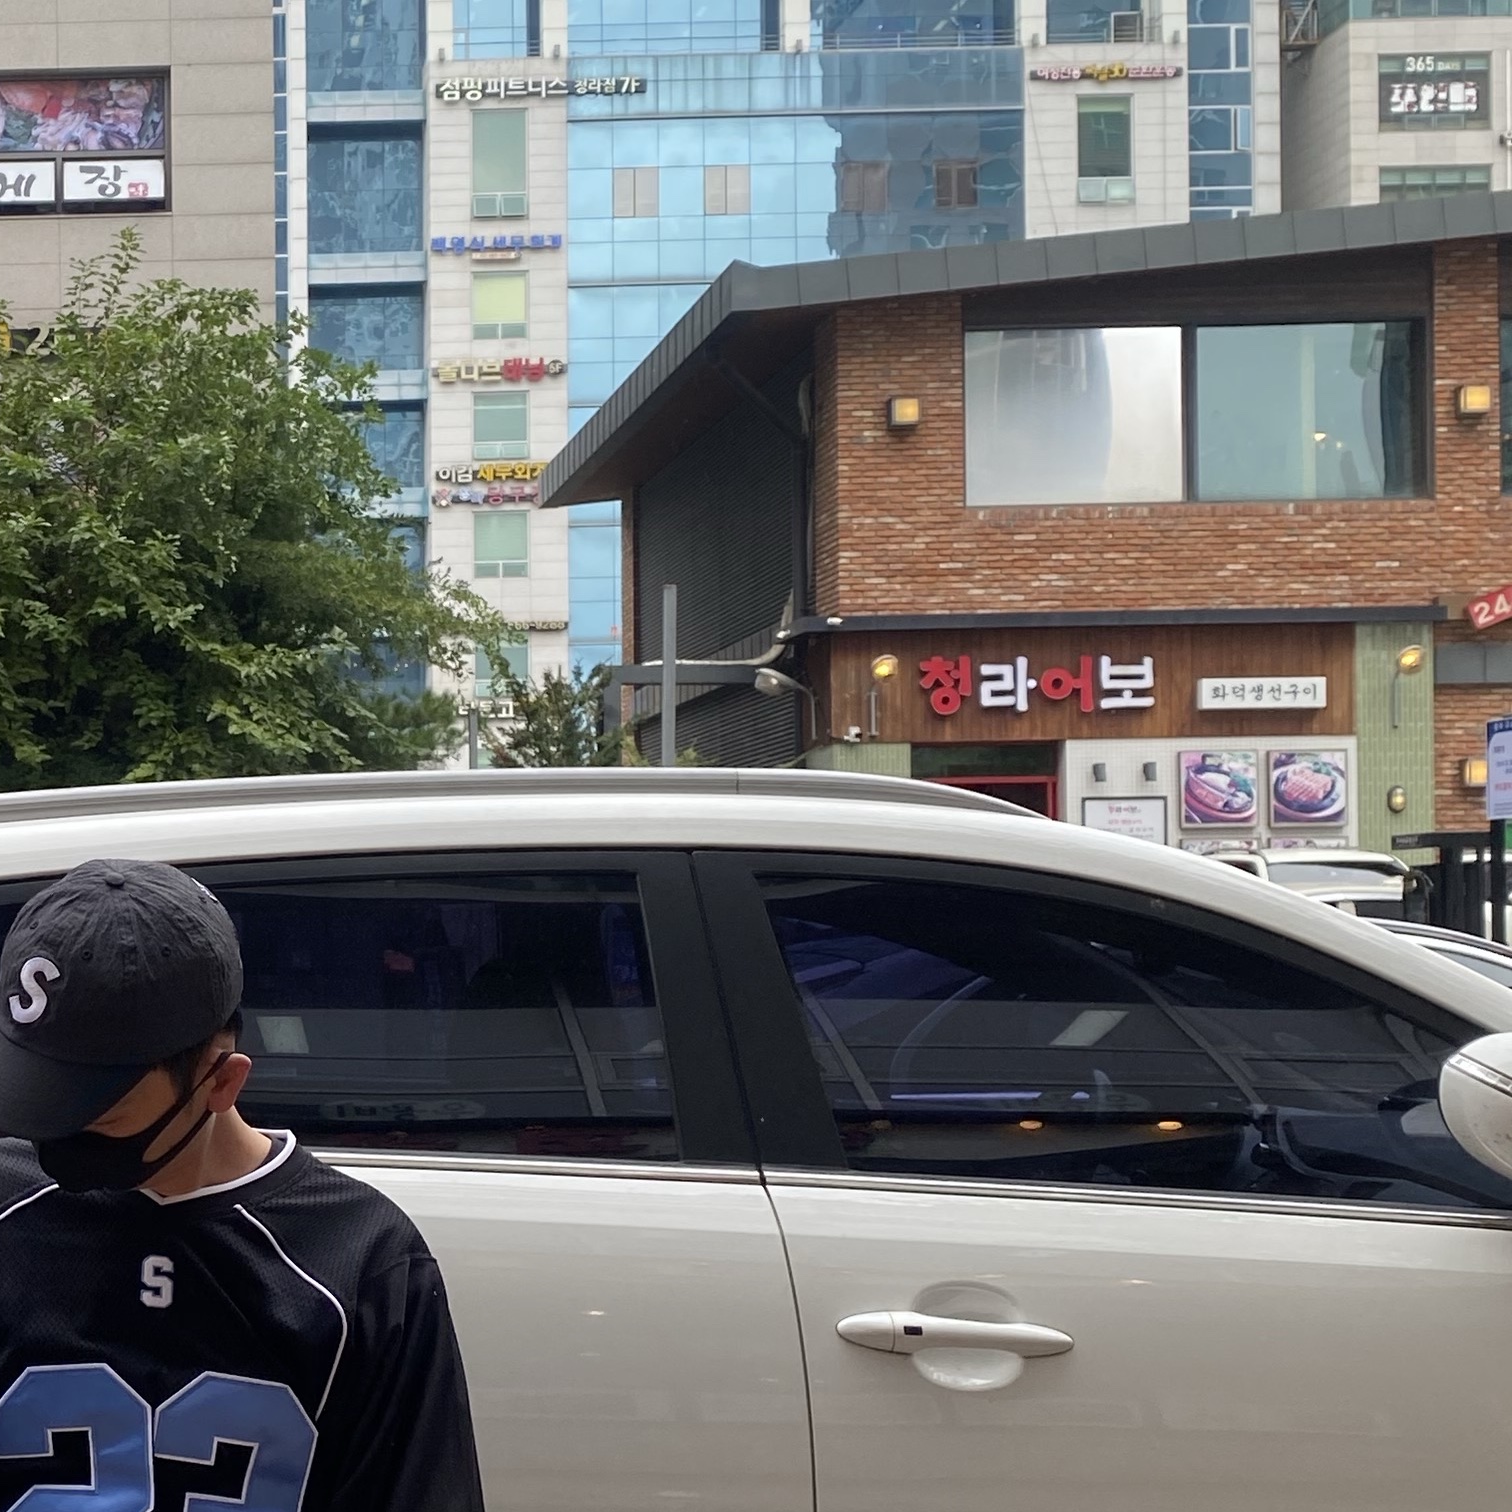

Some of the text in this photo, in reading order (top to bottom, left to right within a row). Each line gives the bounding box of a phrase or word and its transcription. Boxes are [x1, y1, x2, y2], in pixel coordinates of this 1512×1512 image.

[1406, 56, 1435, 72] 365
[440, 77, 641, 101] 점핑피트니스 청라점 7F
[439, 465, 474, 483] 이김
[919, 655, 1156, 715] 청라어보
[1211, 684, 1317, 703] 화덕생선구이
[9, 956, 60, 1023] S
[140, 1255, 174, 1309] S
